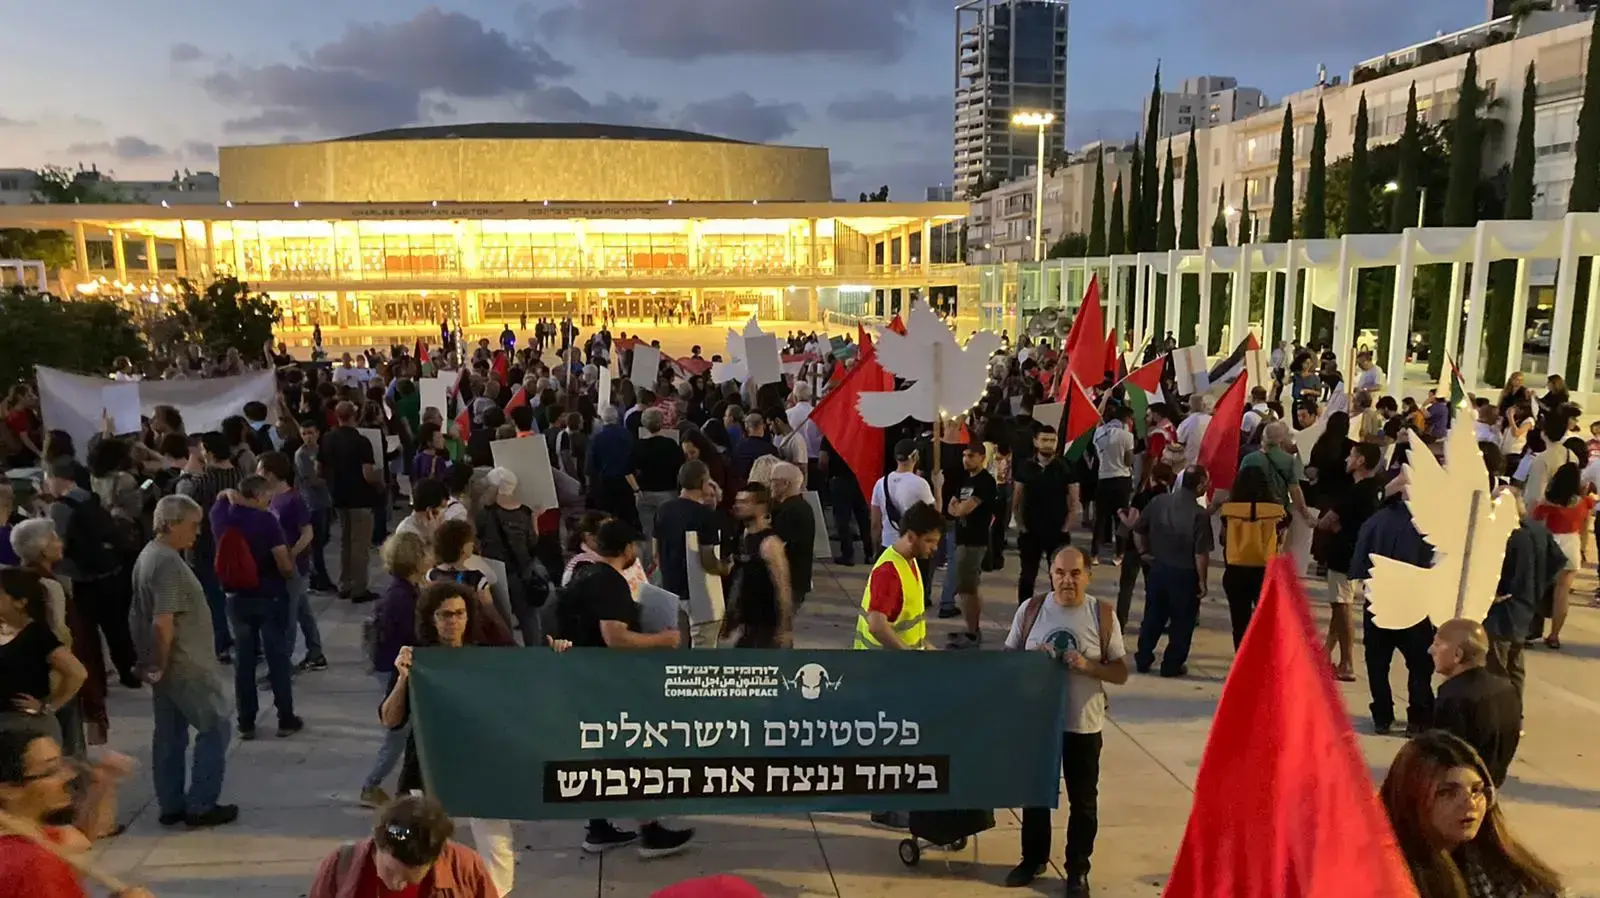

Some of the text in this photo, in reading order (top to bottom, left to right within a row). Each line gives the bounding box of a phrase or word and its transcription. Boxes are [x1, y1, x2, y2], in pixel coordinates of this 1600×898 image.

[665, 665, 779, 675] לוחמים לשלום
[720, 675, 736, 688] من
[736, 675, 778, 689] مقاتلون
[664, 688, 779, 697] COMBATANTS FOR PEACE
[579, 710, 921, 749] פלסטינים וישראלים
[556, 763, 939, 798] ביחד ננצח את הכיבוש
